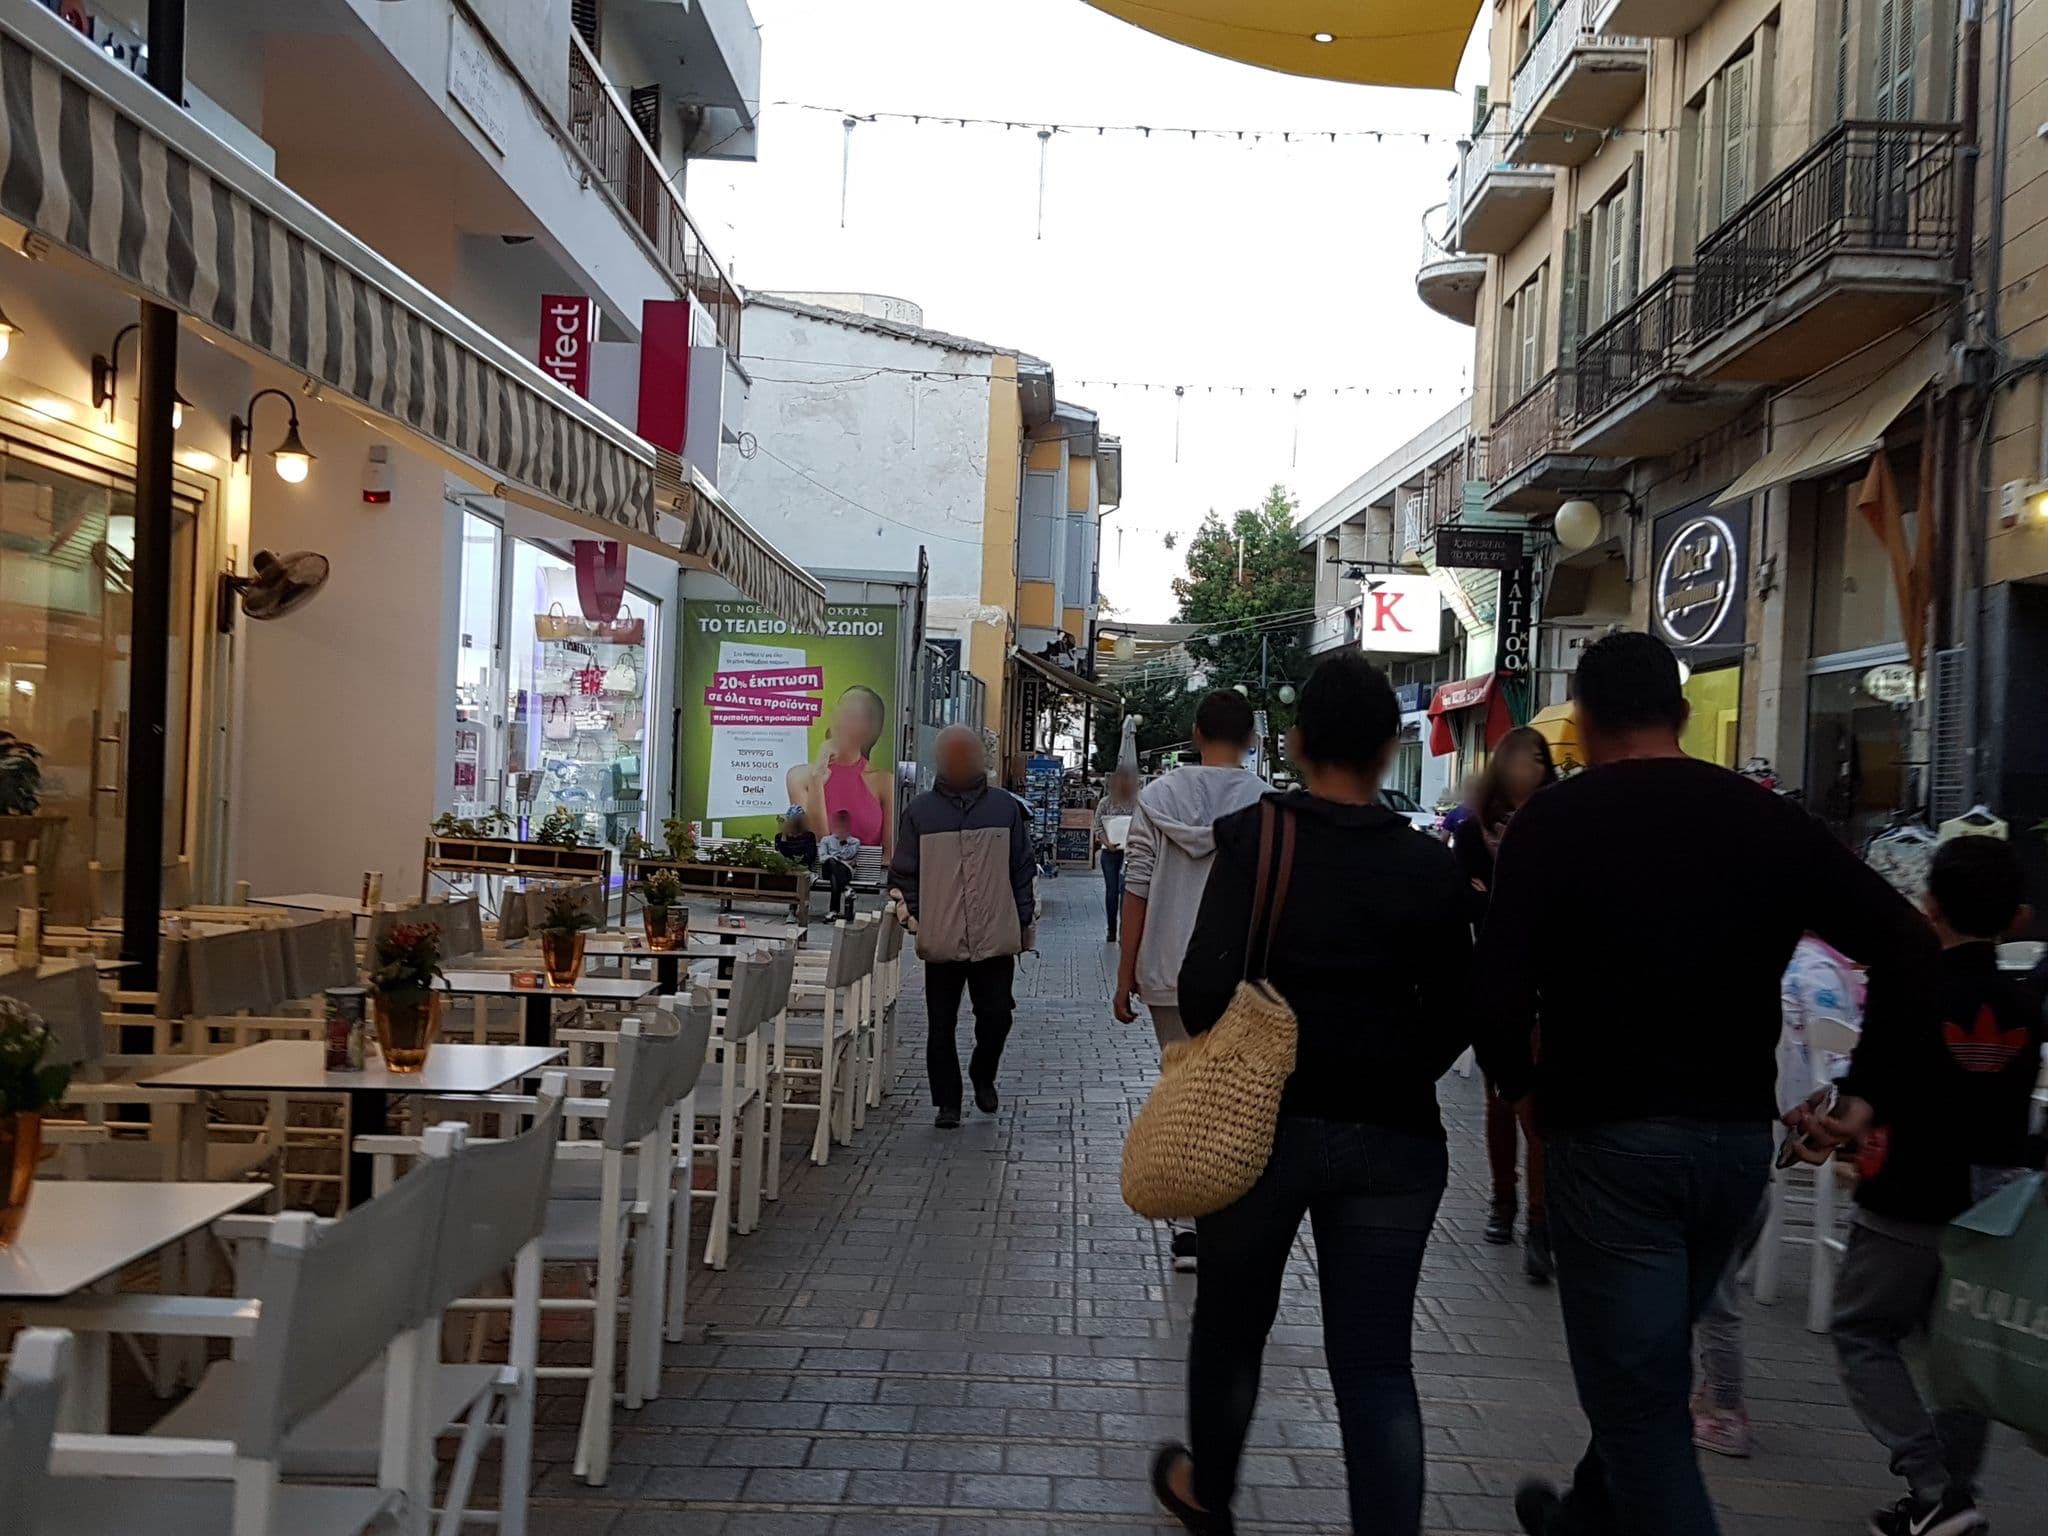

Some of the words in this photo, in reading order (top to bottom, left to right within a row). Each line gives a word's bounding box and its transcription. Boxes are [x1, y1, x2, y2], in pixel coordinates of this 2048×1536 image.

[715, 604, 731, 614] ΤΟ
[827, 607, 869, 617] ΟΚΤΑΣ
[1371, 592, 1413, 633] K
[699, 618, 722, 632] ΤΟ
[725, 618, 787, 634] ΤΕΛΕΙΟ
[790, 620, 884, 637] ΣΩΠΟ!
[719, 675, 747, 690] 20%
[749, 672, 818, 688] έκπτωση
[708, 693, 722, 703] σε
[724, 692, 746, 705] όλα
[748, 697, 762, 707] τα
[764, 697, 818, 712] προϊόντα
[730, 760, 750, 768] SANS
[752, 761, 779, 769] SOUCIS
